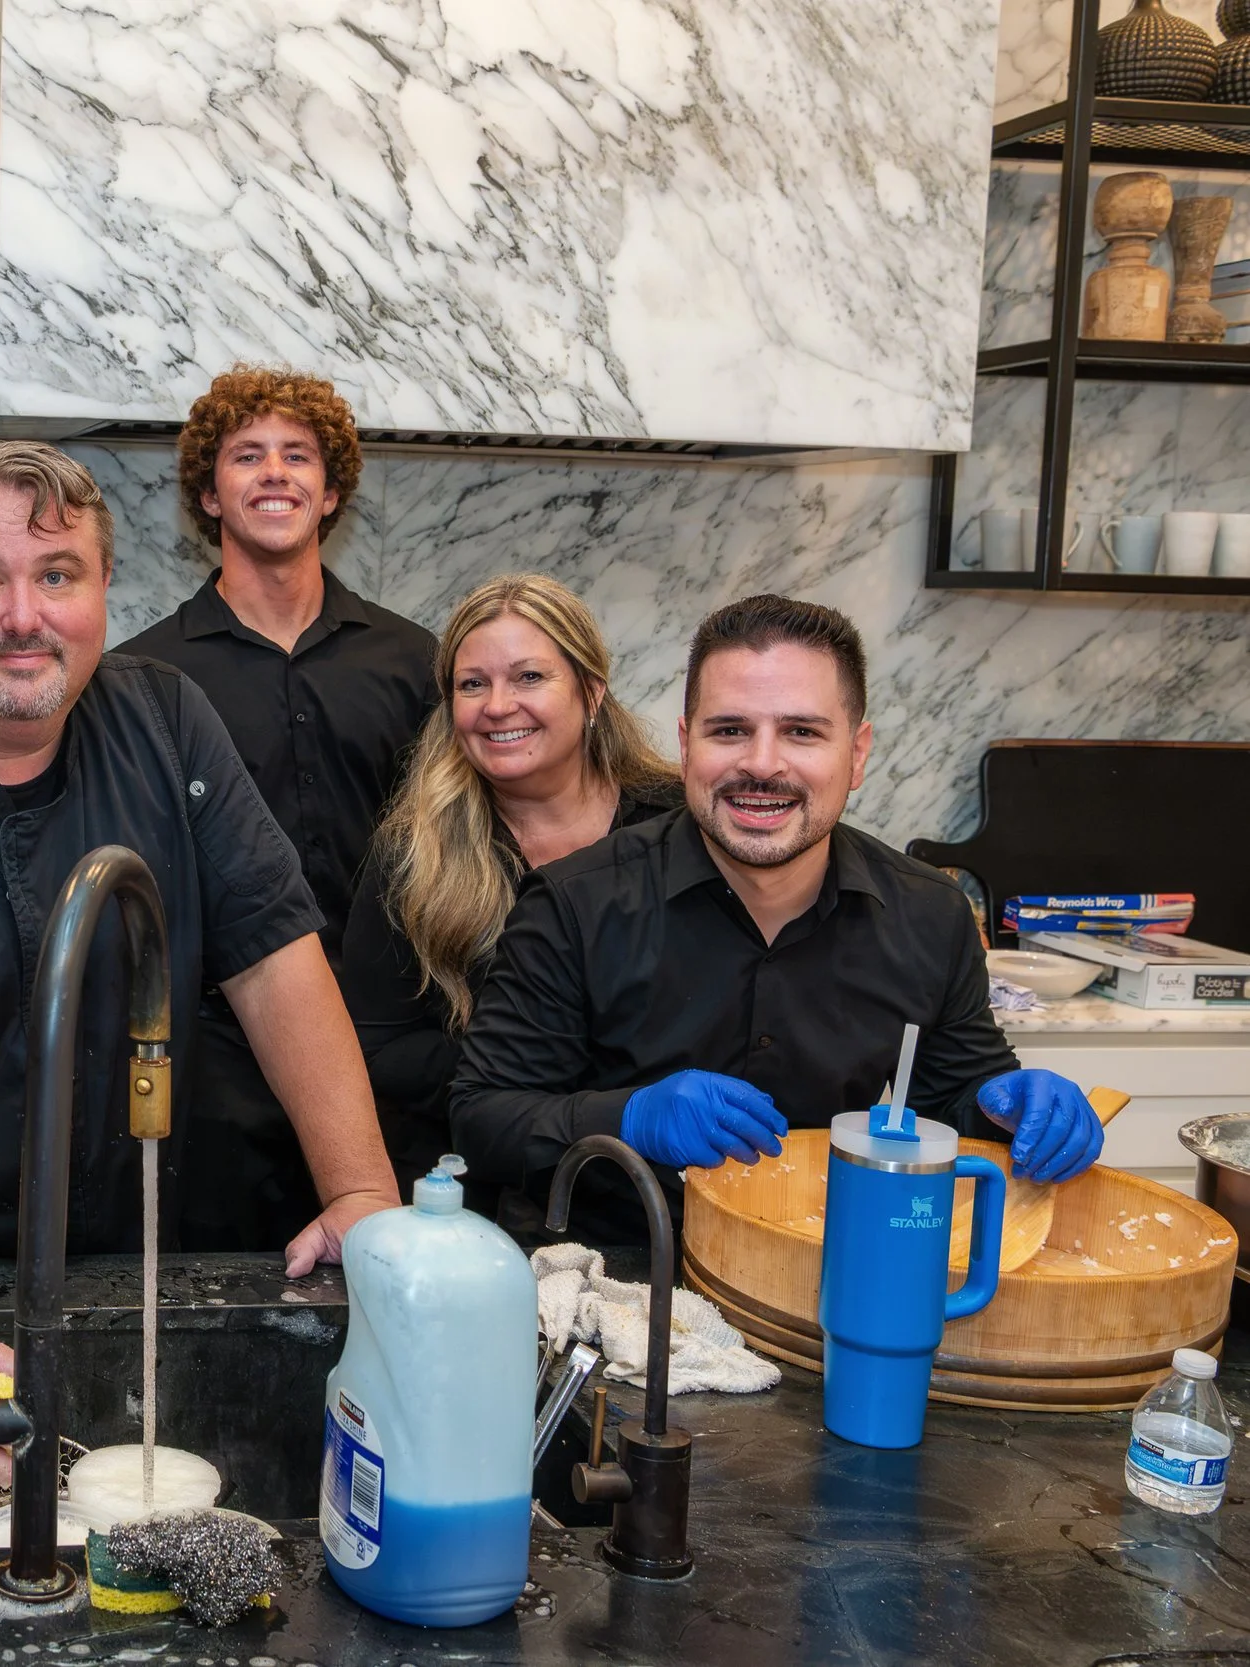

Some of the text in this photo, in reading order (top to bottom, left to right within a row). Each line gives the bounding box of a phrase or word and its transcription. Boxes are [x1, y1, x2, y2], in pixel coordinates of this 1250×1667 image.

[1047, 897, 1125, 908] Reynolds Wrap
[1196, 986, 1235, 997] Candles
[890, 1217, 944, 1229] STANLEY
